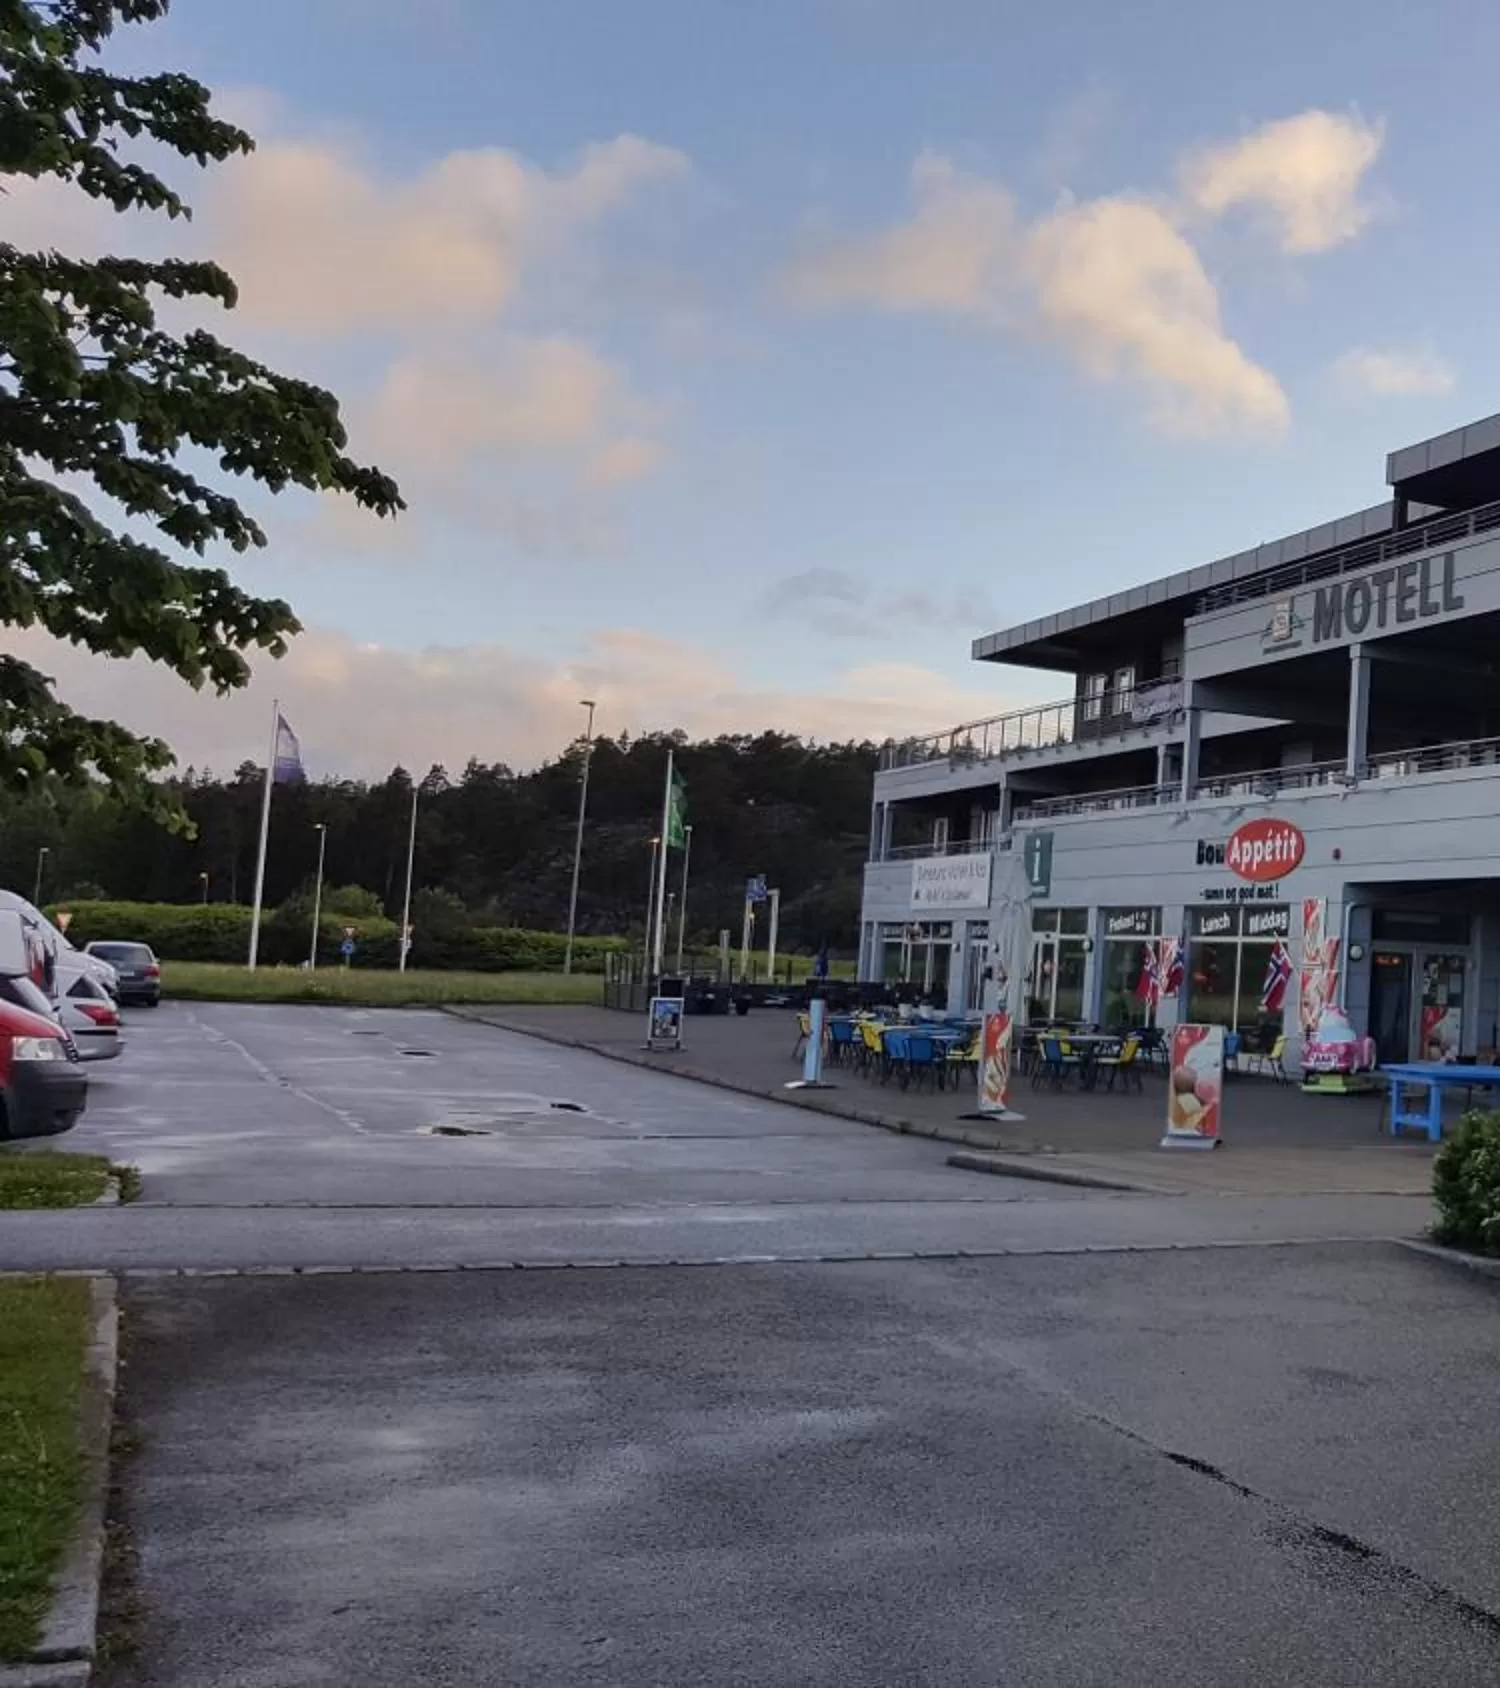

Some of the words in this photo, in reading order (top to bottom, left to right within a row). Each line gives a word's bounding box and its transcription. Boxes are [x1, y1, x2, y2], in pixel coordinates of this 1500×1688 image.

[1312, 551, 1464, 643] MOTELL
[1196, 839, 1225, 866] Bon
[1229, 827, 1297, 872] Appétit
[1201, 911, 1230, 934] Lunch
[1249, 910, 1288, 934] Middag
